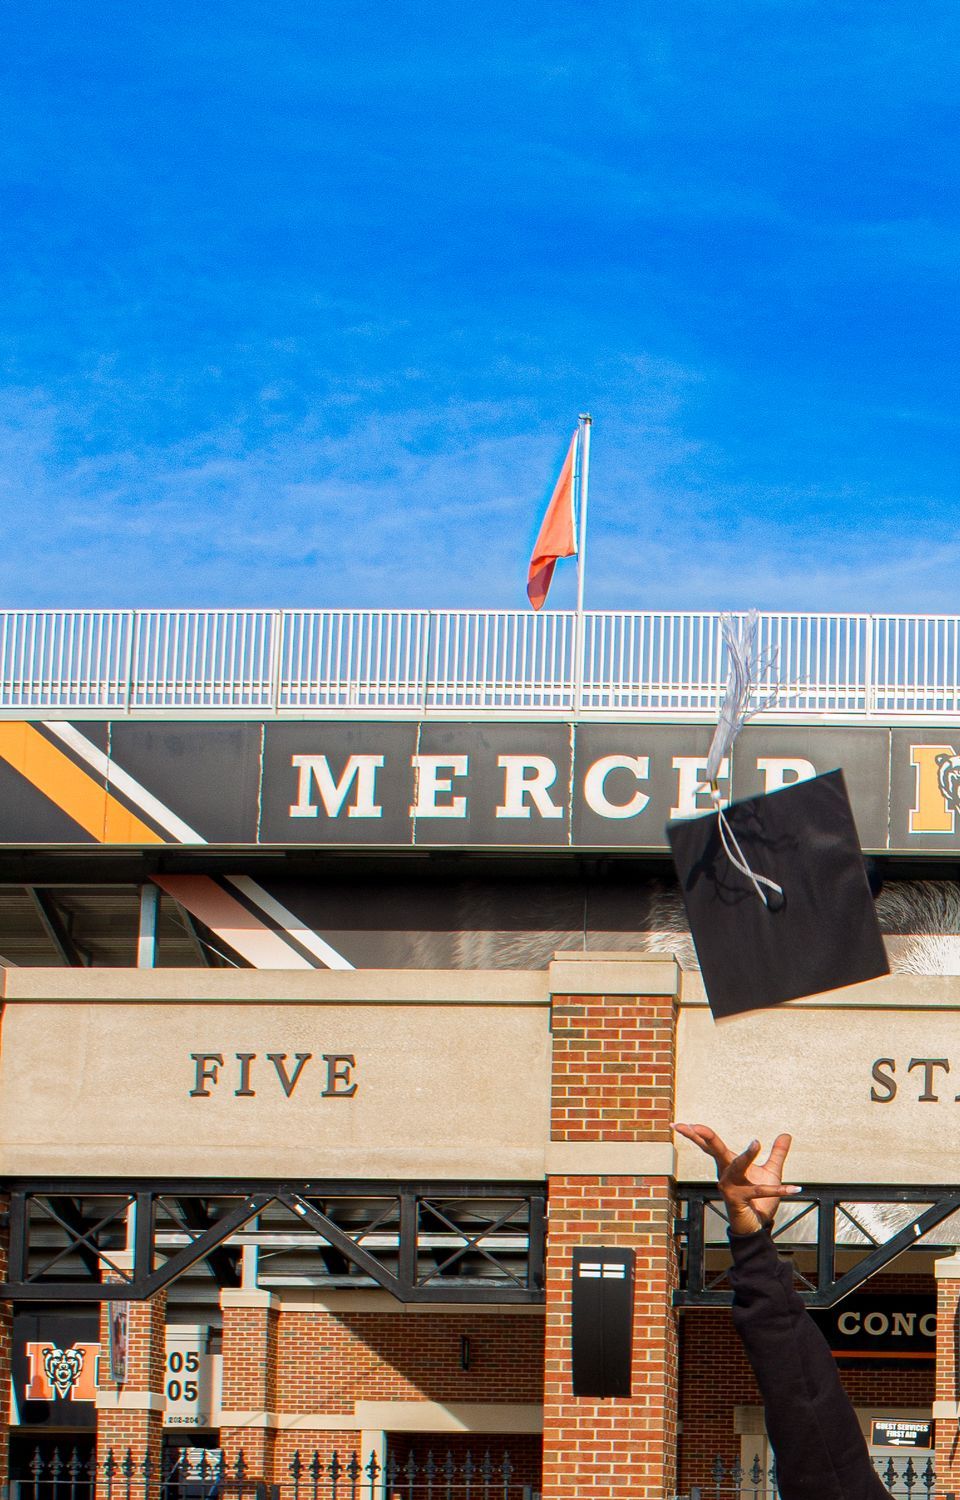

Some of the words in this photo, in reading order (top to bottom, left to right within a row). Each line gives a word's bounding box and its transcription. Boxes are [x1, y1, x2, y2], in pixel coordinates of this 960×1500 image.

[189, 1053, 359, 1098] FIVE
[165, 1351, 200, 1373] 05
[886, 1430, 905, 1438] FIRST
